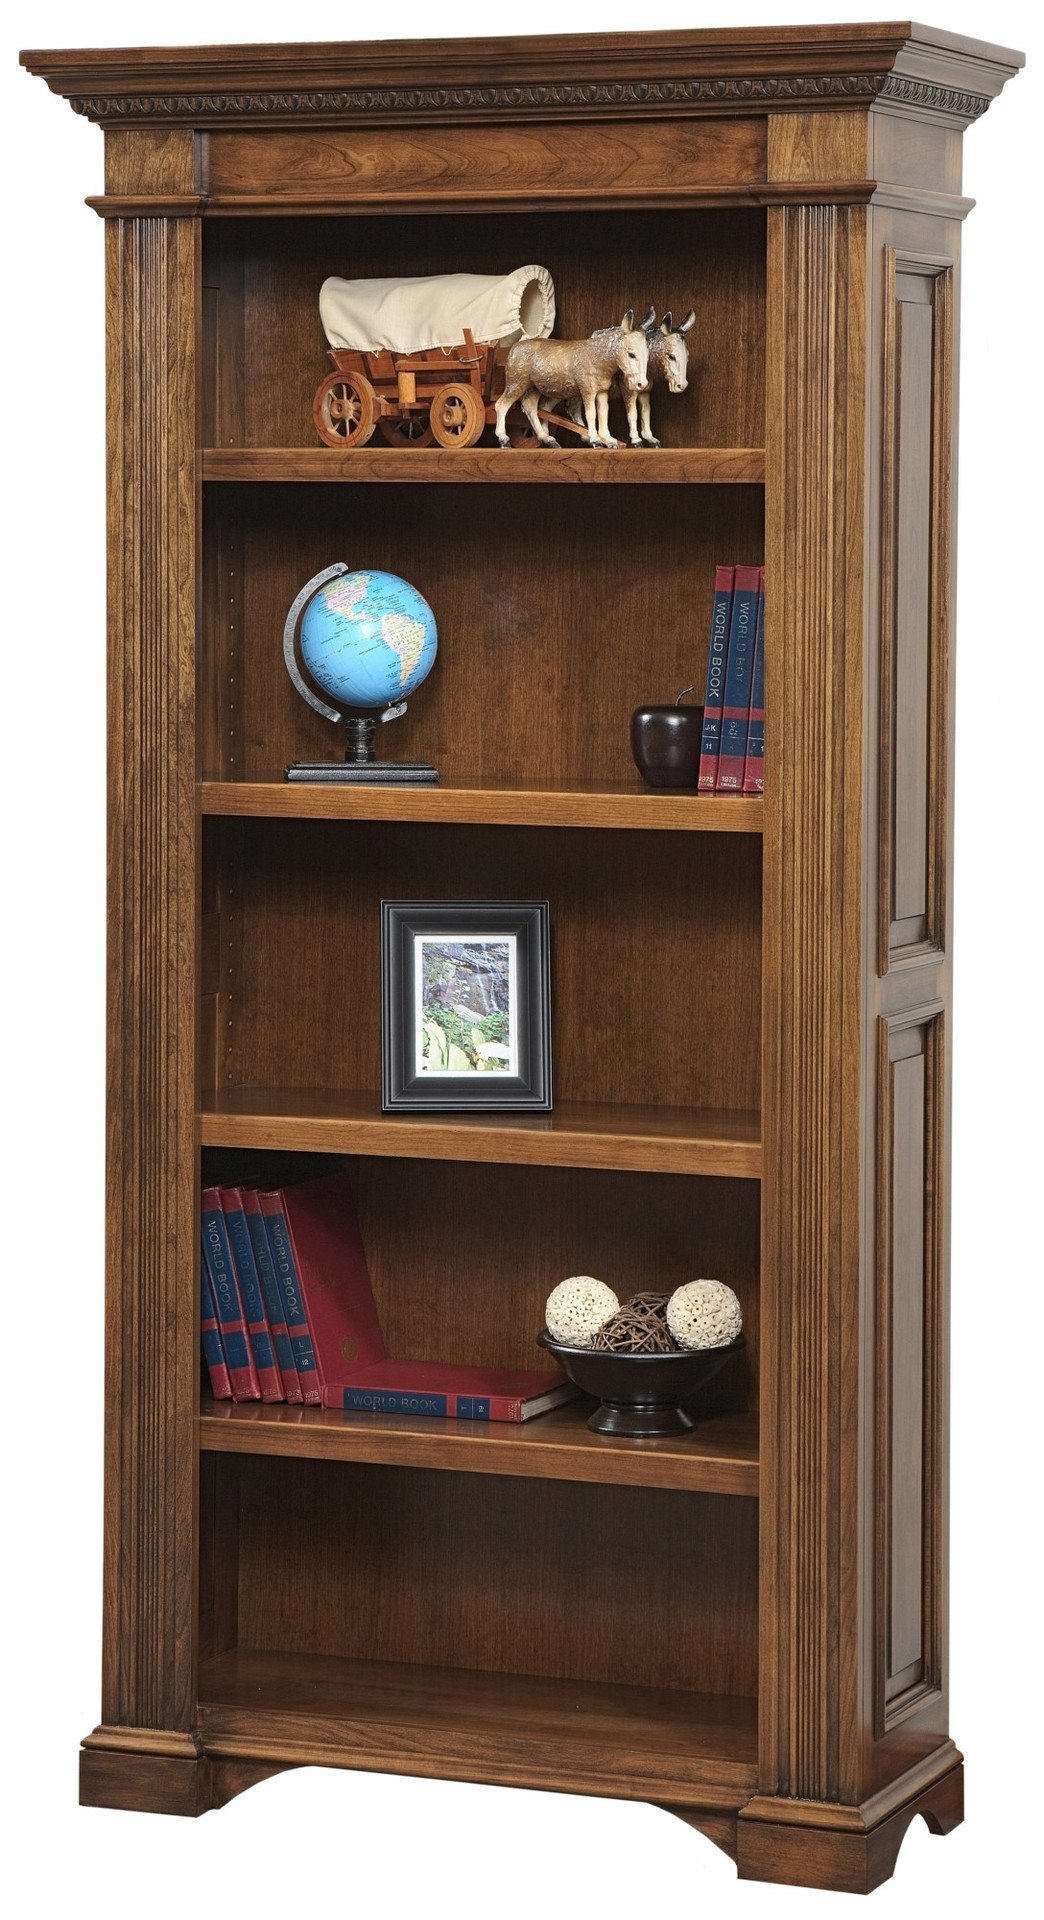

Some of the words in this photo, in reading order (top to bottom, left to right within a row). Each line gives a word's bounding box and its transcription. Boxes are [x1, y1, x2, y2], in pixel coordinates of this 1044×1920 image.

[714, 602, 726, 652] WORLD
[736, 602, 750, 652] WORLD
[709, 657, 723, 697] BOOK
[207, 1220, 225, 1269] WORLD
[217, 1273, 233, 1312] BOOK
[272, 1224, 290, 1273] WORLD
[282, 1277, 300, 1316] BOOK
[301, 1358, 309, 1366] 12
[352, 1394, 397, 1407] WORLD
[401, 1397, 438, 1411] BOOK
